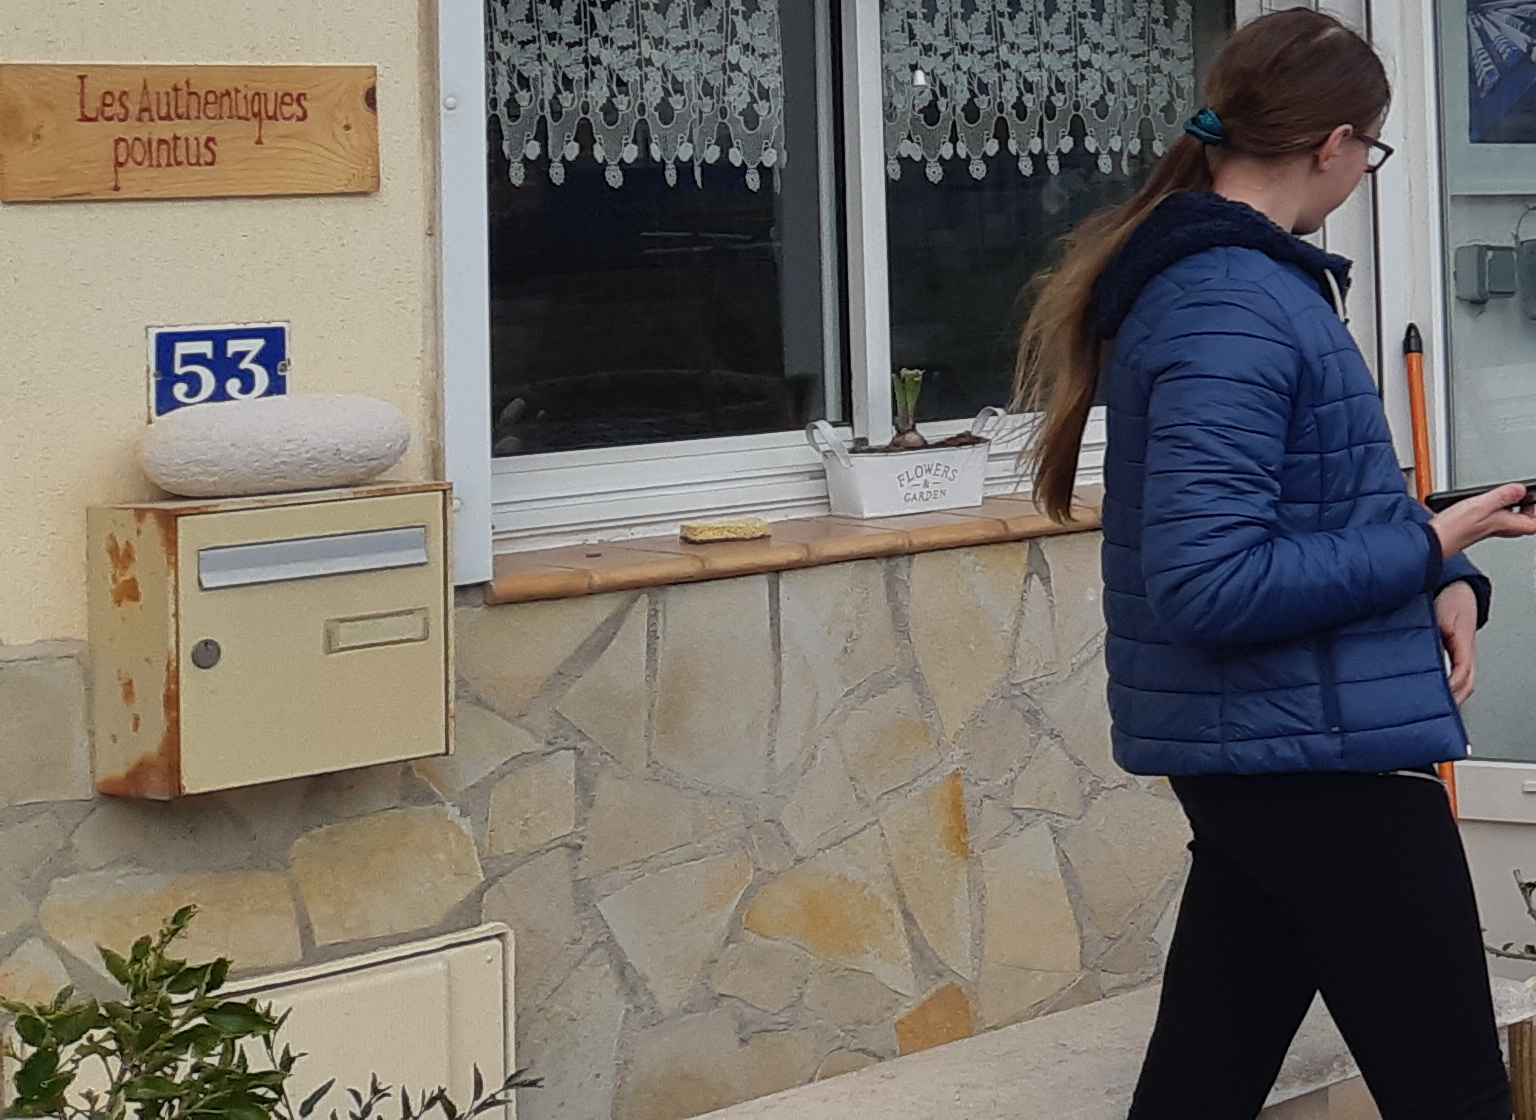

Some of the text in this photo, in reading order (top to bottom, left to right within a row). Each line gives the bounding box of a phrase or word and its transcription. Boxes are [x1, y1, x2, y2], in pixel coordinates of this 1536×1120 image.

[76, 74, 310, 146] Les Authentiques
[111, 132, 218, 192] pointus
[171, 338, 271, 404] 53
[896, 462, 958, 488] FLOWERS
[903, 488, 947, 503] GARDEN
